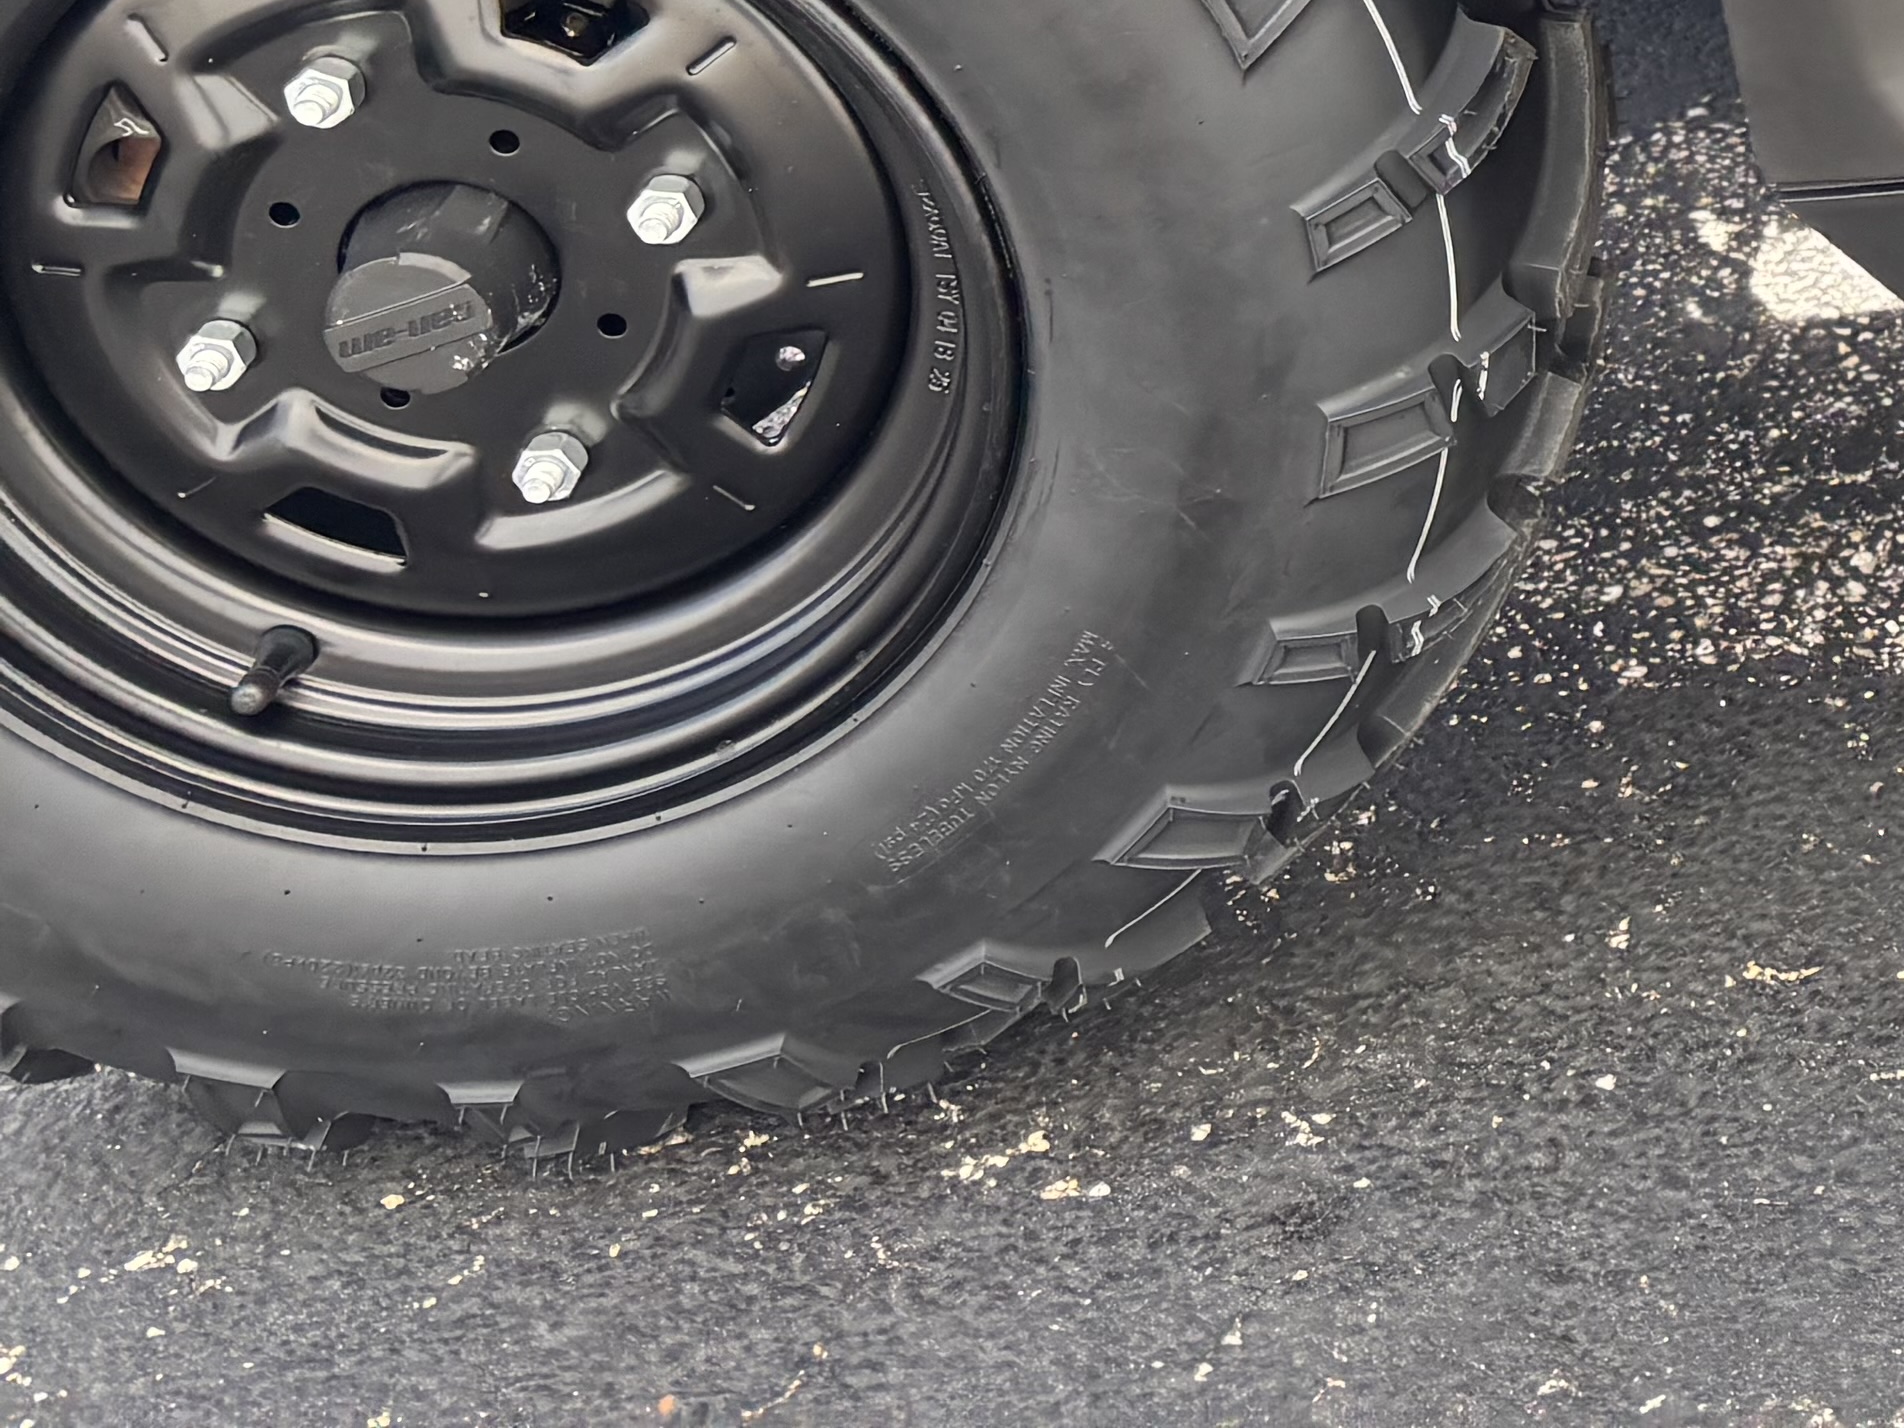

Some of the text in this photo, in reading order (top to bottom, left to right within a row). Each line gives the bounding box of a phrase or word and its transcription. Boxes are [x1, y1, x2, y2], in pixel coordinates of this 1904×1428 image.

[999, 674, 1072, 757] INFLATION
[1026, 692, 1082, 756] RATING
[973, 754, 1030, 807] NYLON
[887, 807, 976, 873] TUBELESS
